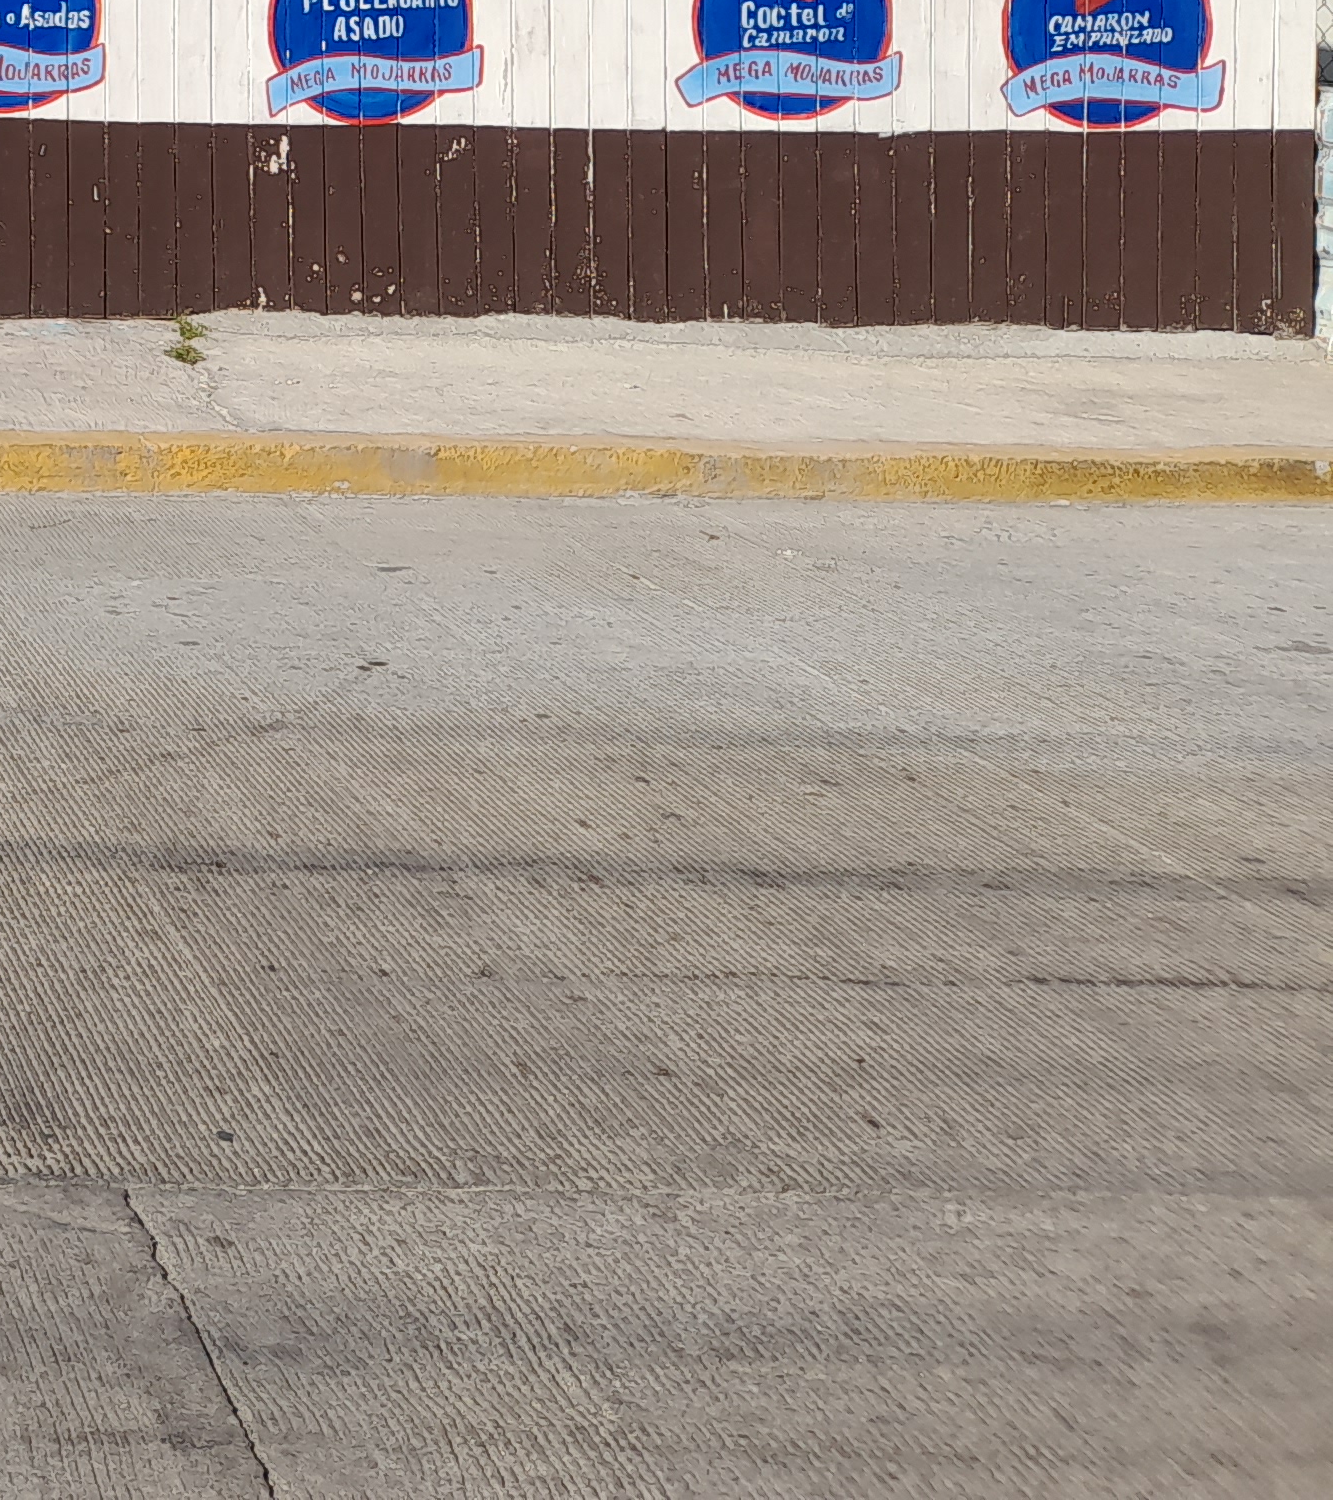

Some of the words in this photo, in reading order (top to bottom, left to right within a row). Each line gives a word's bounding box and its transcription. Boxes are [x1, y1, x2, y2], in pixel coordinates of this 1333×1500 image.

[17, 1, 91, 30] Asadas
[333, 15, 404, 41] ASADO
[740, 1, 826, 29] Coctel
[1048, 11, 1151, 34] CAMARON
[742, 26, 845, 48] Camaron
[1050, 27, 1173, 52] EMPANIZADO
[289, 67, 337, 94] MEGA
[350, 62, 453, 84] MOJARRAS
[716, 60, 773, 85] MEGA
[785, 61, 884, 87] MOJARRAS
[1023, 69, 1073, 100] MEGA
[1079, 61, 1181, 90] MOJARRAS
